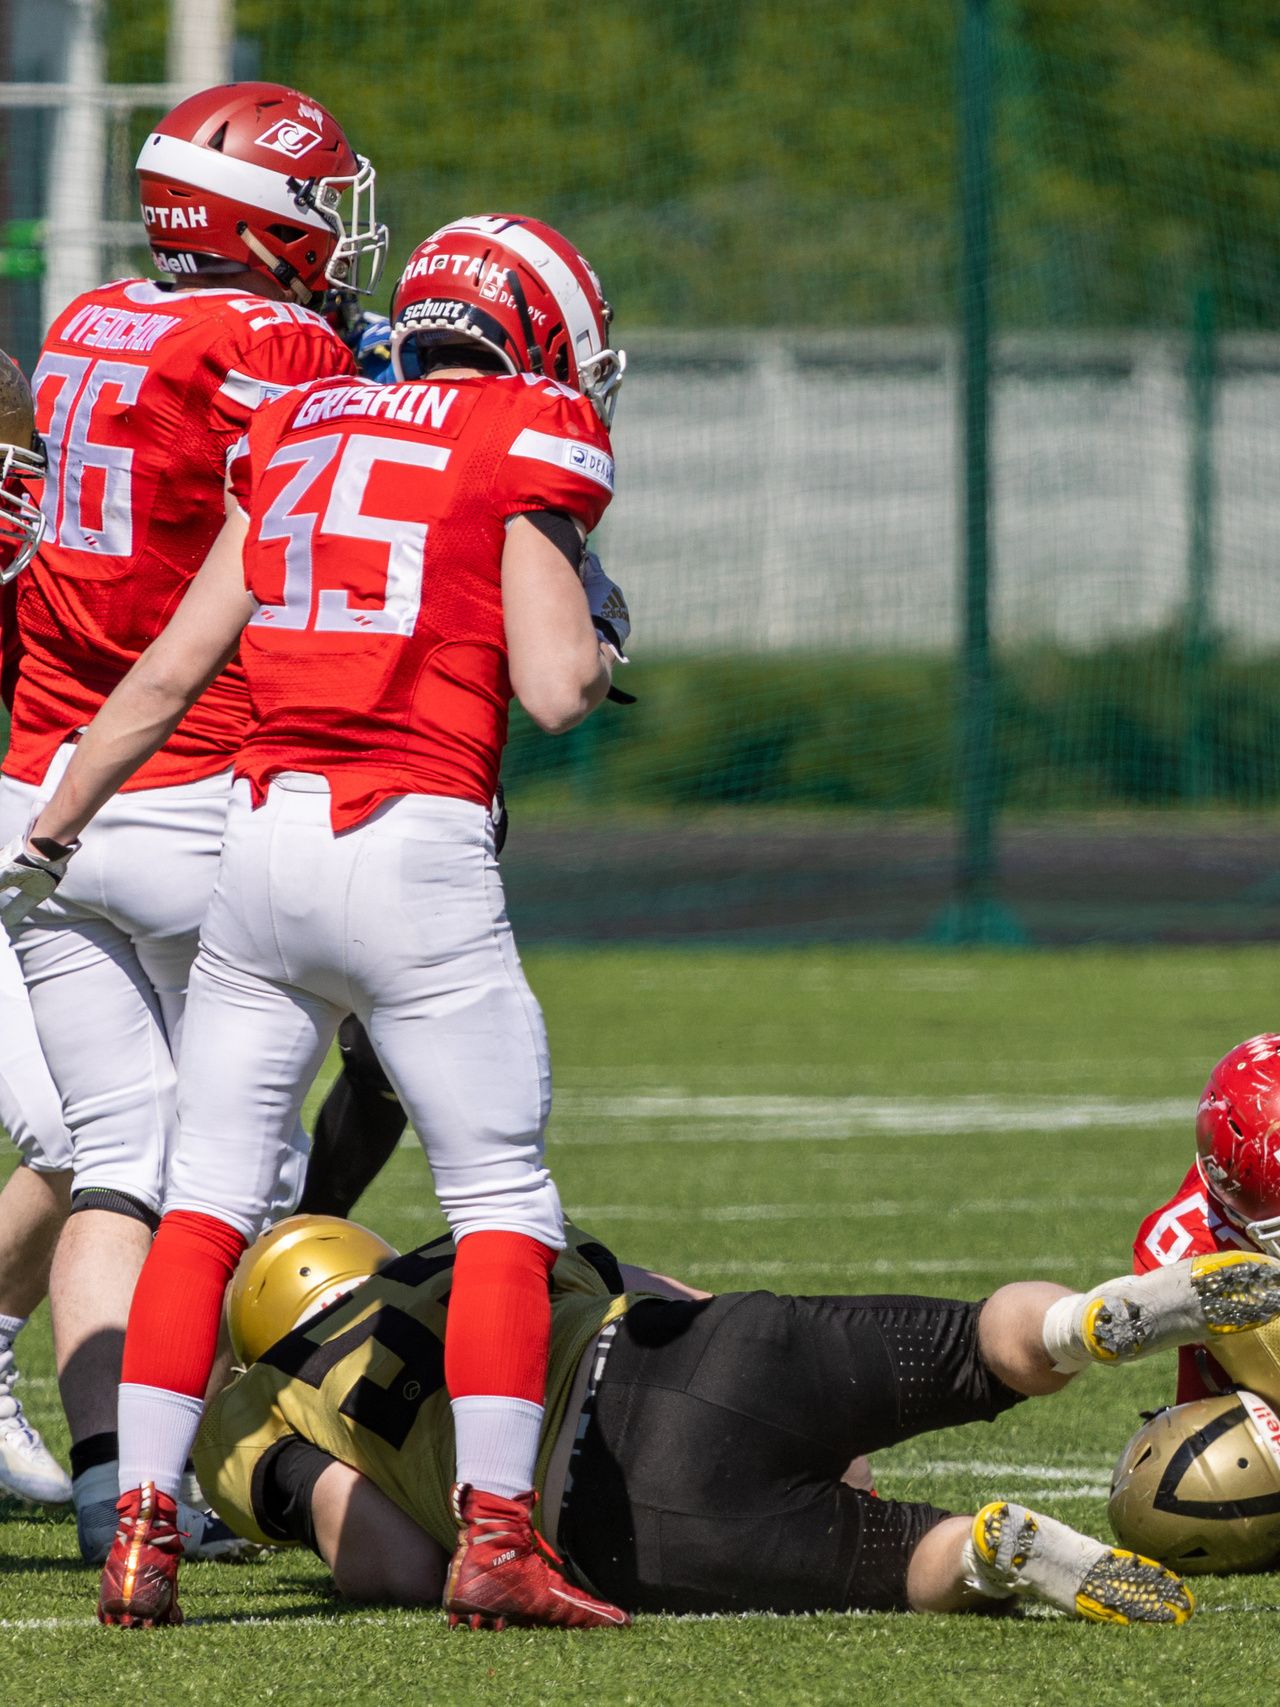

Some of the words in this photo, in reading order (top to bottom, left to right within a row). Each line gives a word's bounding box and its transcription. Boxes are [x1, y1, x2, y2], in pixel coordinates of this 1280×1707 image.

[60, 304, 182, 351] VYSOCHIN
[403, 298, 464, 321] schutt
[291, 384, 459, 430] GRISHIN
[247, 433, 452, 637] 35
[492, 1549, 516, 1567] VAPOR
